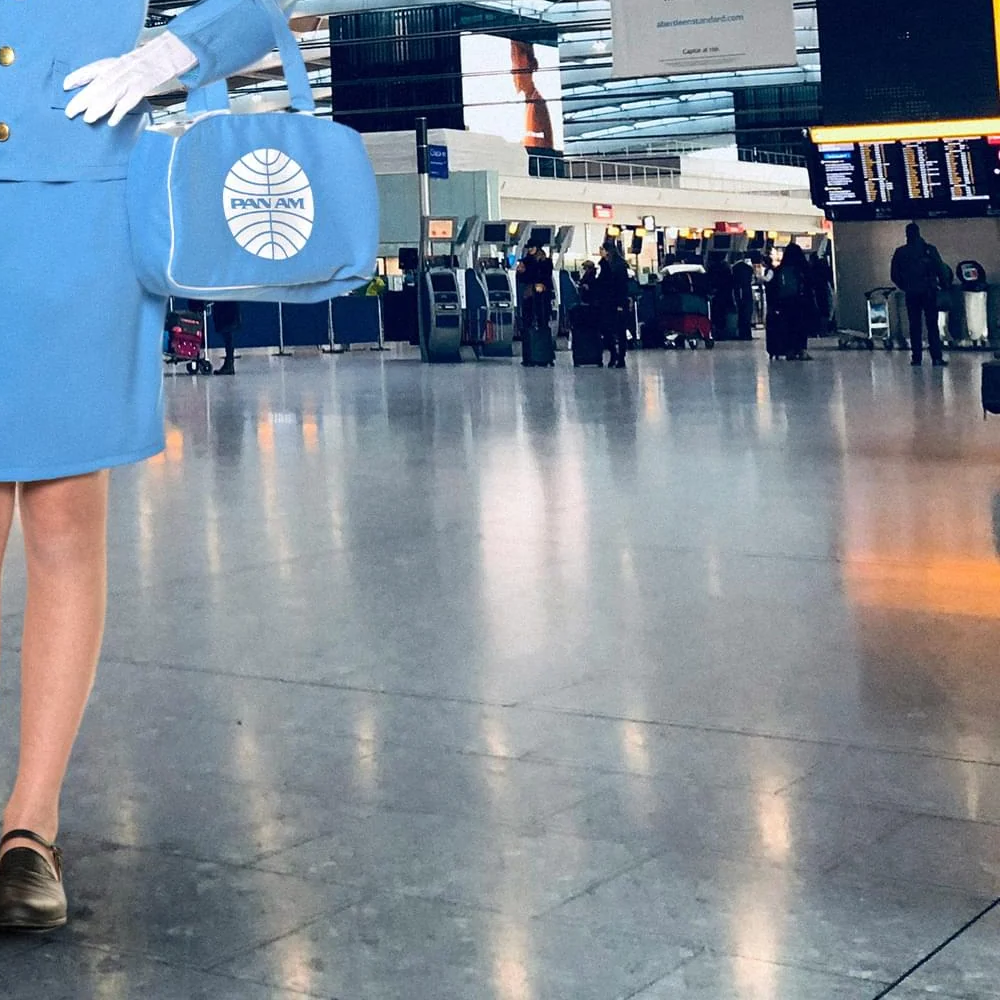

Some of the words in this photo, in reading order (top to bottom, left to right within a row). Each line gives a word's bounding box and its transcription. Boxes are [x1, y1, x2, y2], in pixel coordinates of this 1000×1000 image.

[656, 14, 744, 29] aberdeenstandard.com
[230, 197, 272, 210] PAN
[274, 197, 305, 210] AM
